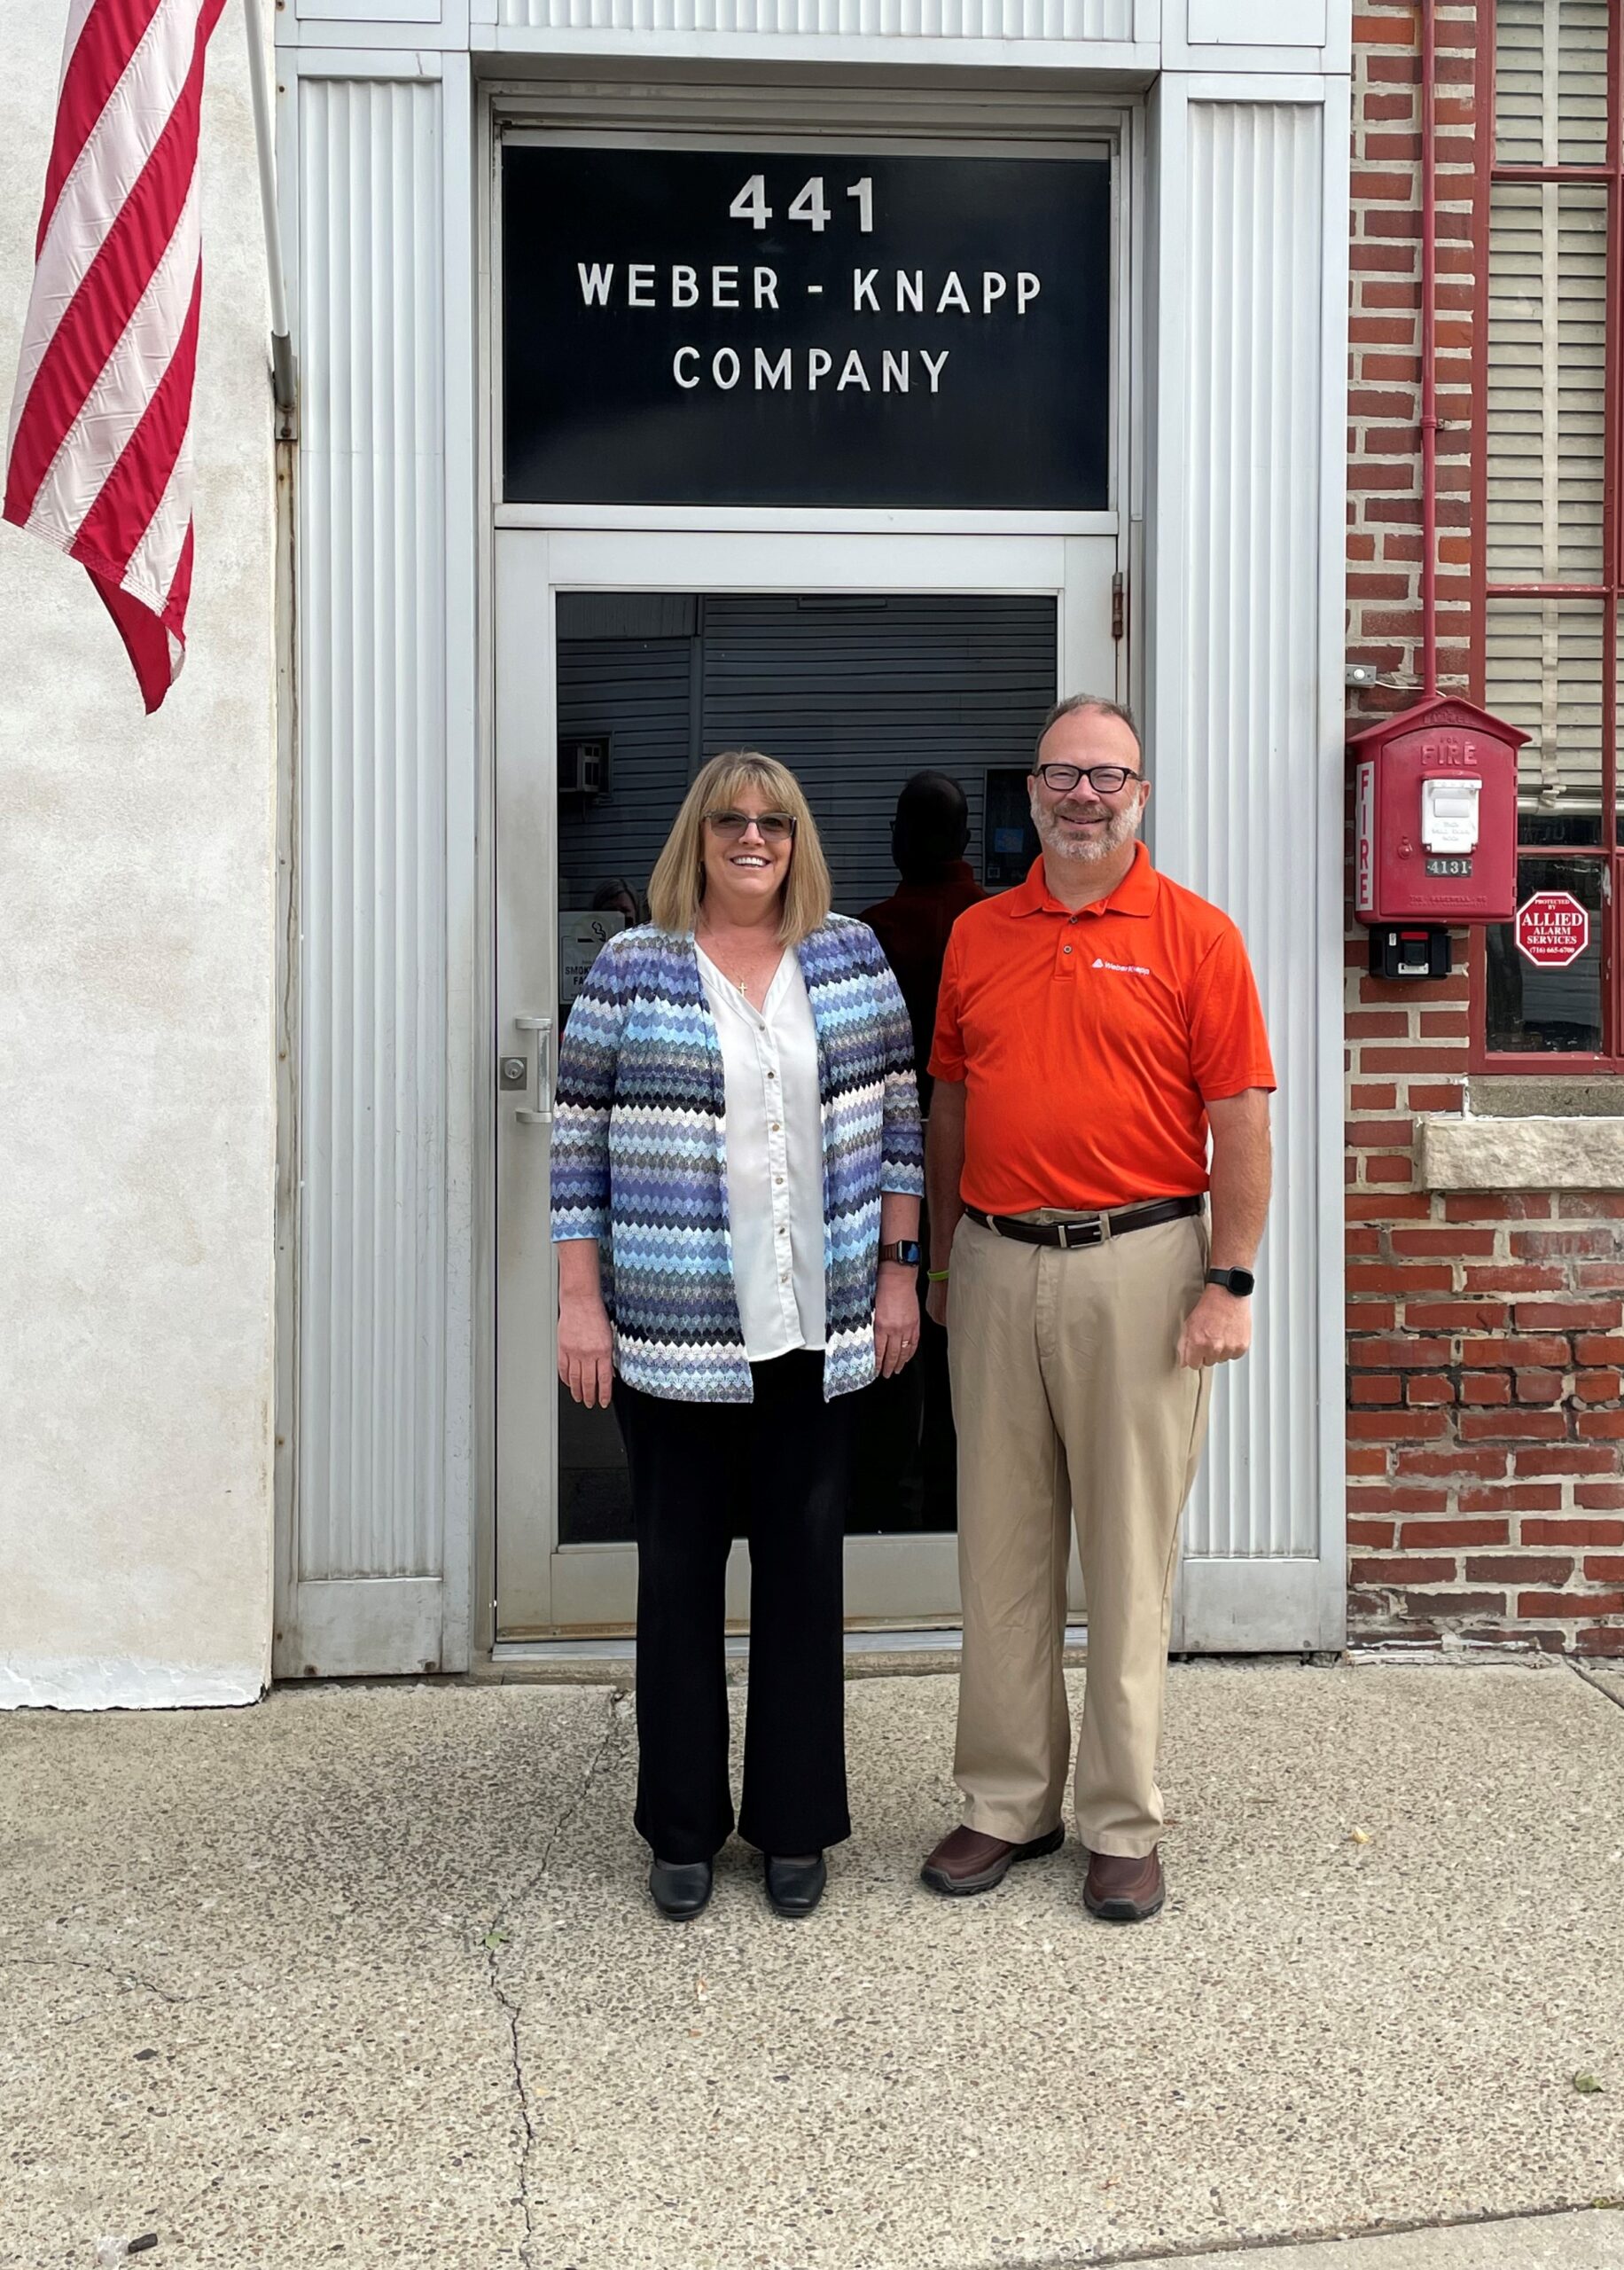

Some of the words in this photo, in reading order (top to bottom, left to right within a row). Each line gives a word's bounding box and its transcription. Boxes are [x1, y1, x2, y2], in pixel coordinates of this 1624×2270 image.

[730, 175, 873, 232] 441
[577, 262, 779, 309] WEBER
[854, 268, 1041, 315] KNAPP
[673, 346, 949, 393] COMPANY
[1421, 743, 1477, 766] FIRE
[1360, 769, 1370, 904] FIRE
[1430, 861, 1468, 873] 4131
[1521, 912, 1583, 927] ALLIED
[1526, 935, 1577, 944] SERVICES
[1533, 927, 1571, 935] ALARM
[565, 966, 592, 975] SMOK
